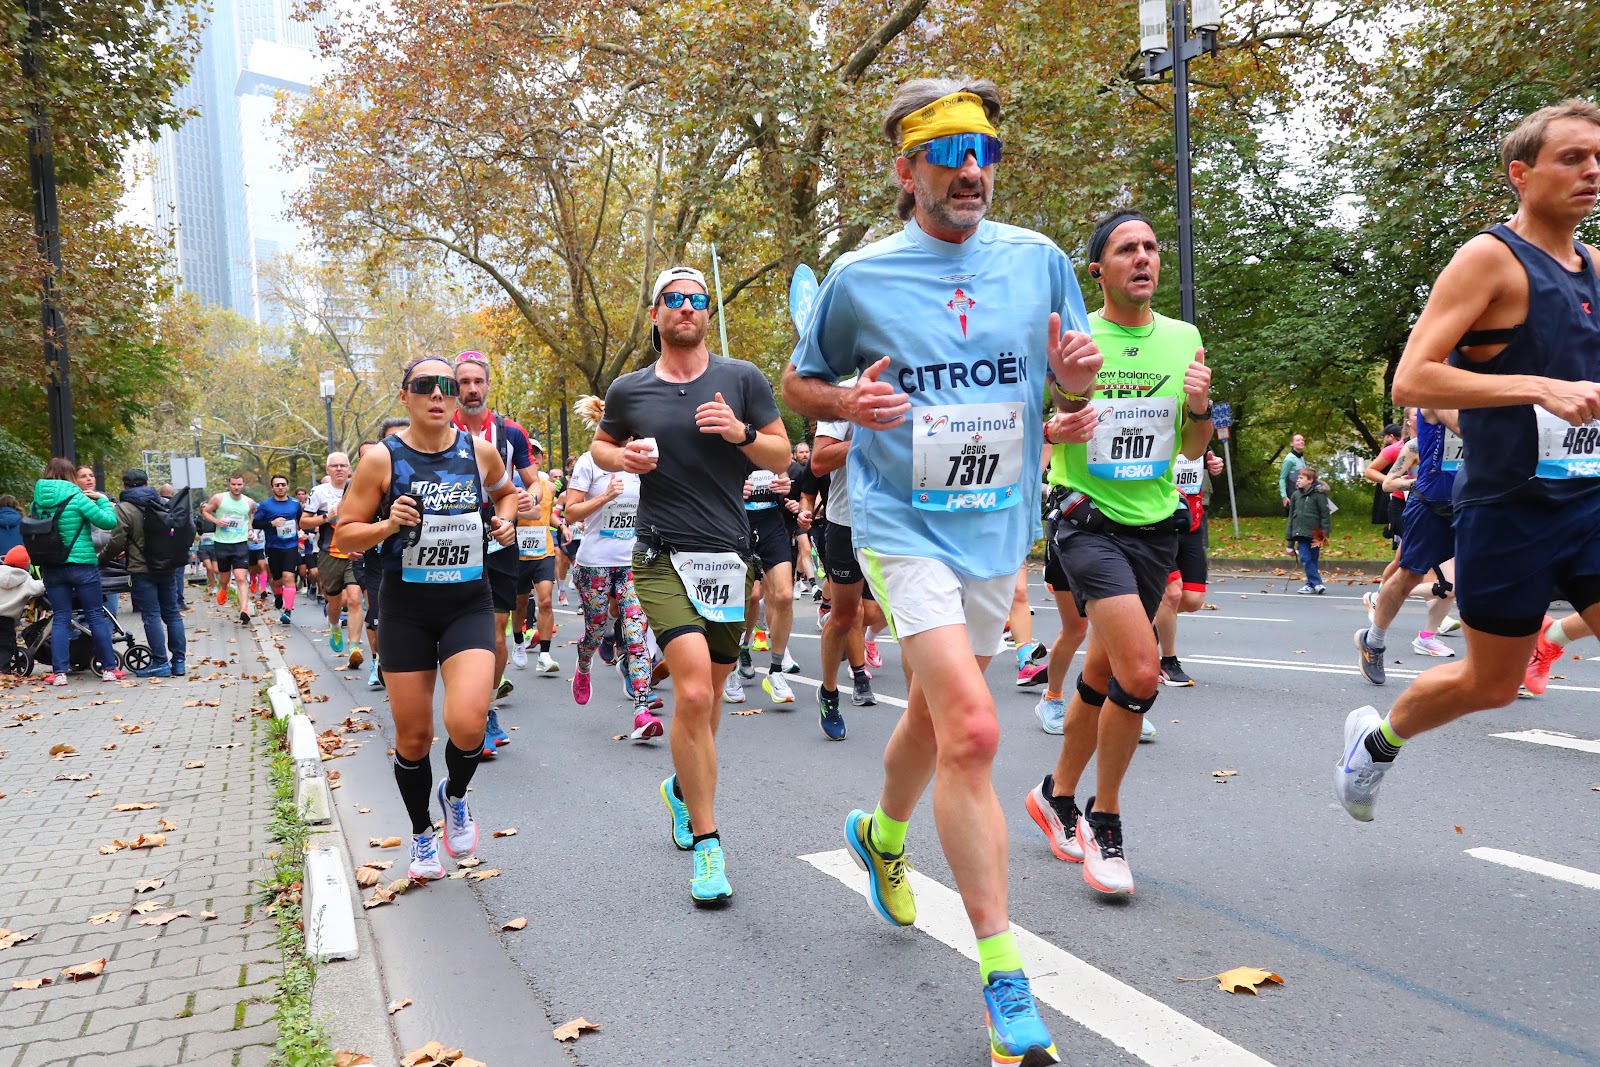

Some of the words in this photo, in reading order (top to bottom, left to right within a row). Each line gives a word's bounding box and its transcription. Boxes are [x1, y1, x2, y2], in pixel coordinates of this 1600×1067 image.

[898, 352, 1028, 394] CITROËN
[1119, 370, 1162, 381] balance
[1115, 408, 1169, 420] mainova
[950, 417, 1016, 433] mainova
[1121, 427, 1143, 436] Hector
[961, 444, 986, 454] Jesus
[1111, 435, 1155, 459] 6107
[945, 454, 1000, 486] 7317
[1114, 465, 1154, 478] HOKA
[1176, 472, 1198, 484] 1905
[417, 481, 448, 494] TIDE
[946, 492, 996, 509] HOKA
[428, 523, 477, 533] mainova
[521, 539, 539, 549] 9372
[417, 545, 470, 566] F2935
[693, 561, 741, 571] mainova
[425, 570, 462, 582] HOKA
